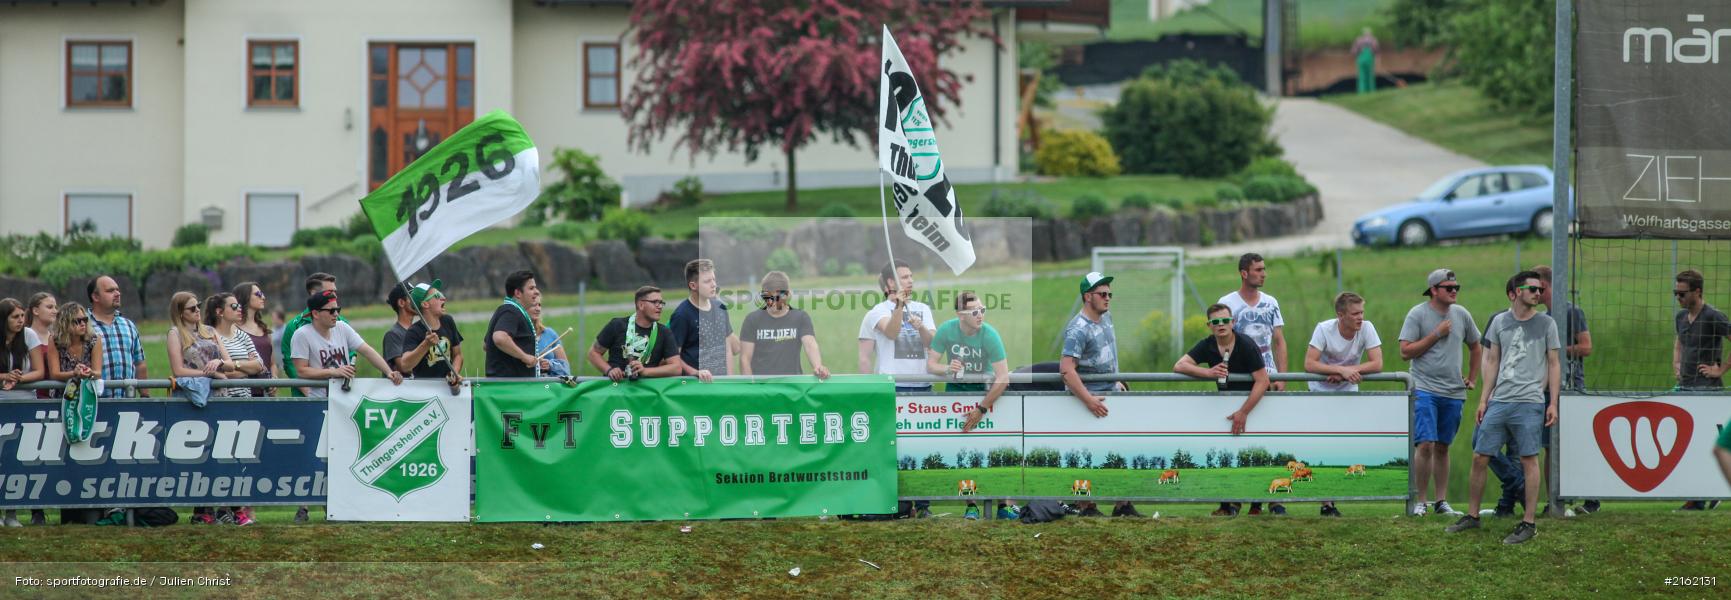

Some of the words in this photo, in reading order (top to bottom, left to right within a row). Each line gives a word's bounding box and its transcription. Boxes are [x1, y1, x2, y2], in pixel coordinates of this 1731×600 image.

[395, 132, 516, 239] 1926
[1623, 214, 1731, 232] Wolfhartsgasse
[908, 402, 947, 413] Staus
[951, 402, 993, 413] Gm
[364, 408, 398, 429] FV
[917, 418, 941, 429] und
[946, 418, 993, 429] Flech
[360, 424, 424, 477] Thüngersheim
[399, 462, 438, 477] 1926
[716, 472, 765, 484] Sektion
[769, 469, 868, 483] Bratwurststand
[0, 474, 48, 499] 97
